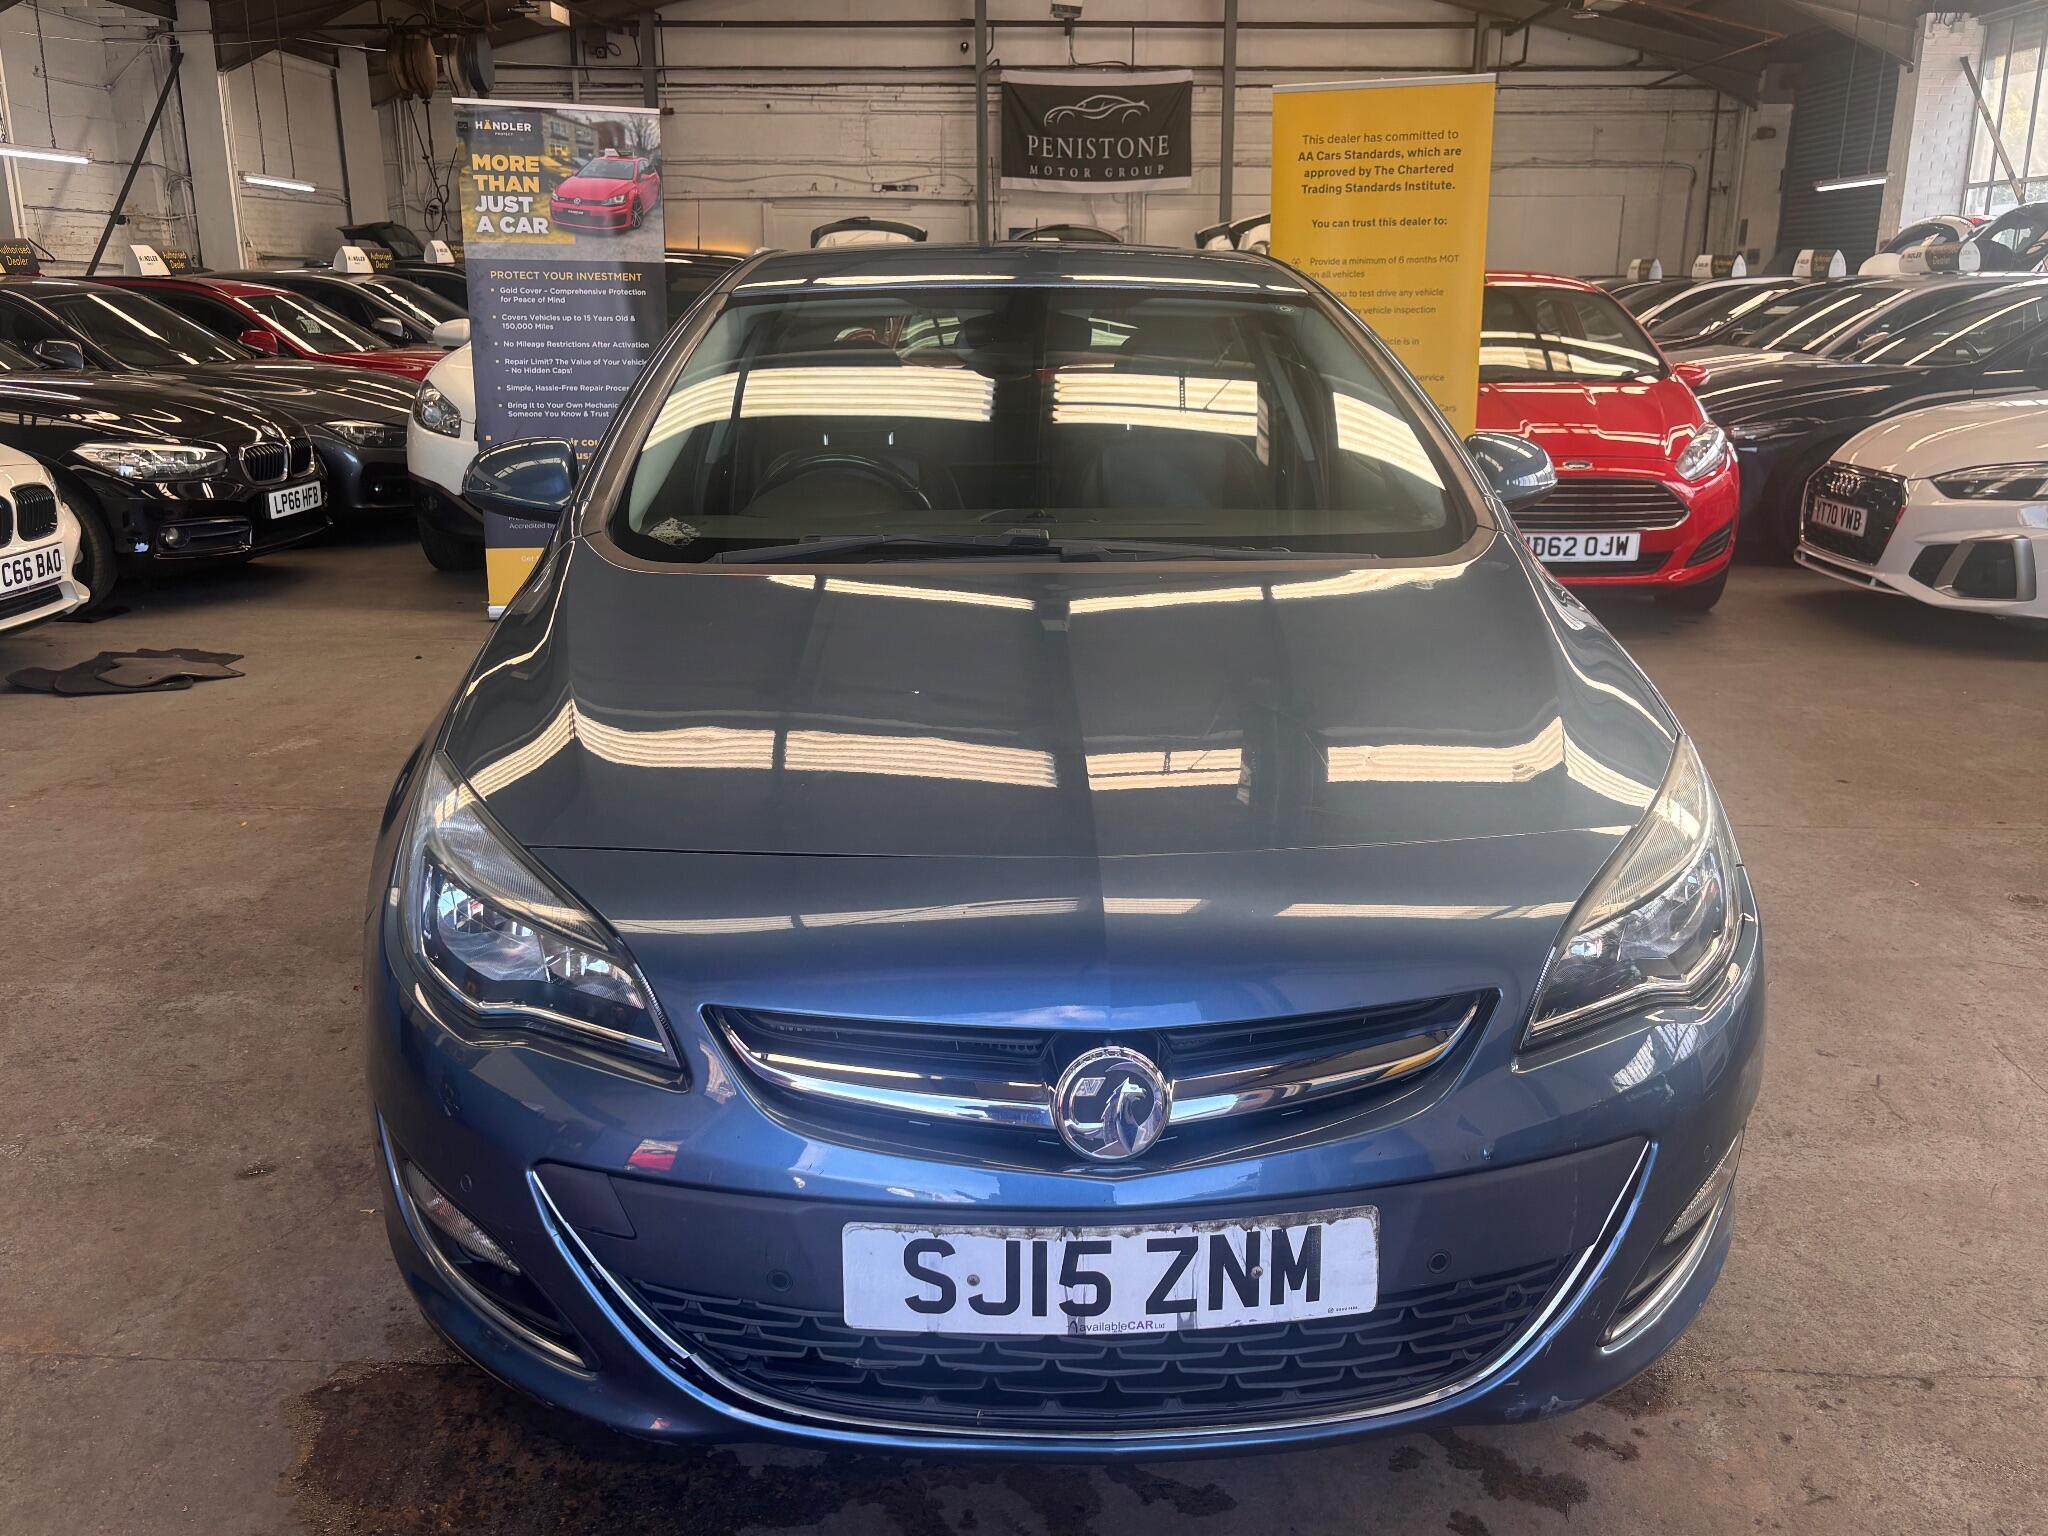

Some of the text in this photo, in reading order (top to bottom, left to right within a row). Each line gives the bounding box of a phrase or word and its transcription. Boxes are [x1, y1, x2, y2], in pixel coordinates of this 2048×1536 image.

[1302, 129, 1459, 145] This dealer has committed to
[1027, 135, 1170, 159] PENISTONE
[1298, 147, 1461, 161] AA Cars Standards, which are
[472, 153, 540, 172] MORE
[1029, 164, 1165, 178] MOTOR GROUP
[1304, 163, 1454, 179] approved by The Chartered
[473, 174, 540, 193] THAN
[1302, 181, 1455, 195] Trading Standards Institute.
[475, 195, 533, 213] JUST
[477, 215, 549, 234] A CAR
[1312, 217, 1447, 229] You can trust this dealer to:
[1310, 257, 1340, 265] Provide
[1349, 256, 1387, 265] minimum
[1389, 256, 1397, 264] of
[1399, 256, 1405, 264] 6
[1406, 255, 1437, 264] months
[1440, 255, 1459, 263] MOT
[491, 271, 642, 282] PROTECT YOUR INVESTMENT
[609, 288, 647, 296] Protection
[1350, 288, 1357, 298] to
[1360, 288, 1375, 298] test
[1377, 288, 1397, 298] drive
[1399, 290, 1413, 298] any
[1415, 288, 1444, 296] vehicle
[1364, 306, 1391, 314] vehicle
[1394, 305, 1436, 315] inspection
[584, 314, 591, 322] 15
[593, 314, 613, 322] Years
[615, 314, 629, 322] Old
[505, 358, 528, 366] Repair
[531, 358, 553, 366] Limit?
[555, 358, 569, 366] The
[571, 358, 592, 366] Value
[593, 358, 601, 366] of
[603, 358, 620, 366] Your
[274, 486, 318, 514] LP66 HFB
[1584, 535, 1630, 556] OJW
[36, 548, 61, 578] BAO
[904, 1225, 1322, 1317] SJ15 ZNM
[1080, 1320, 1154, 1332] availableCAR
